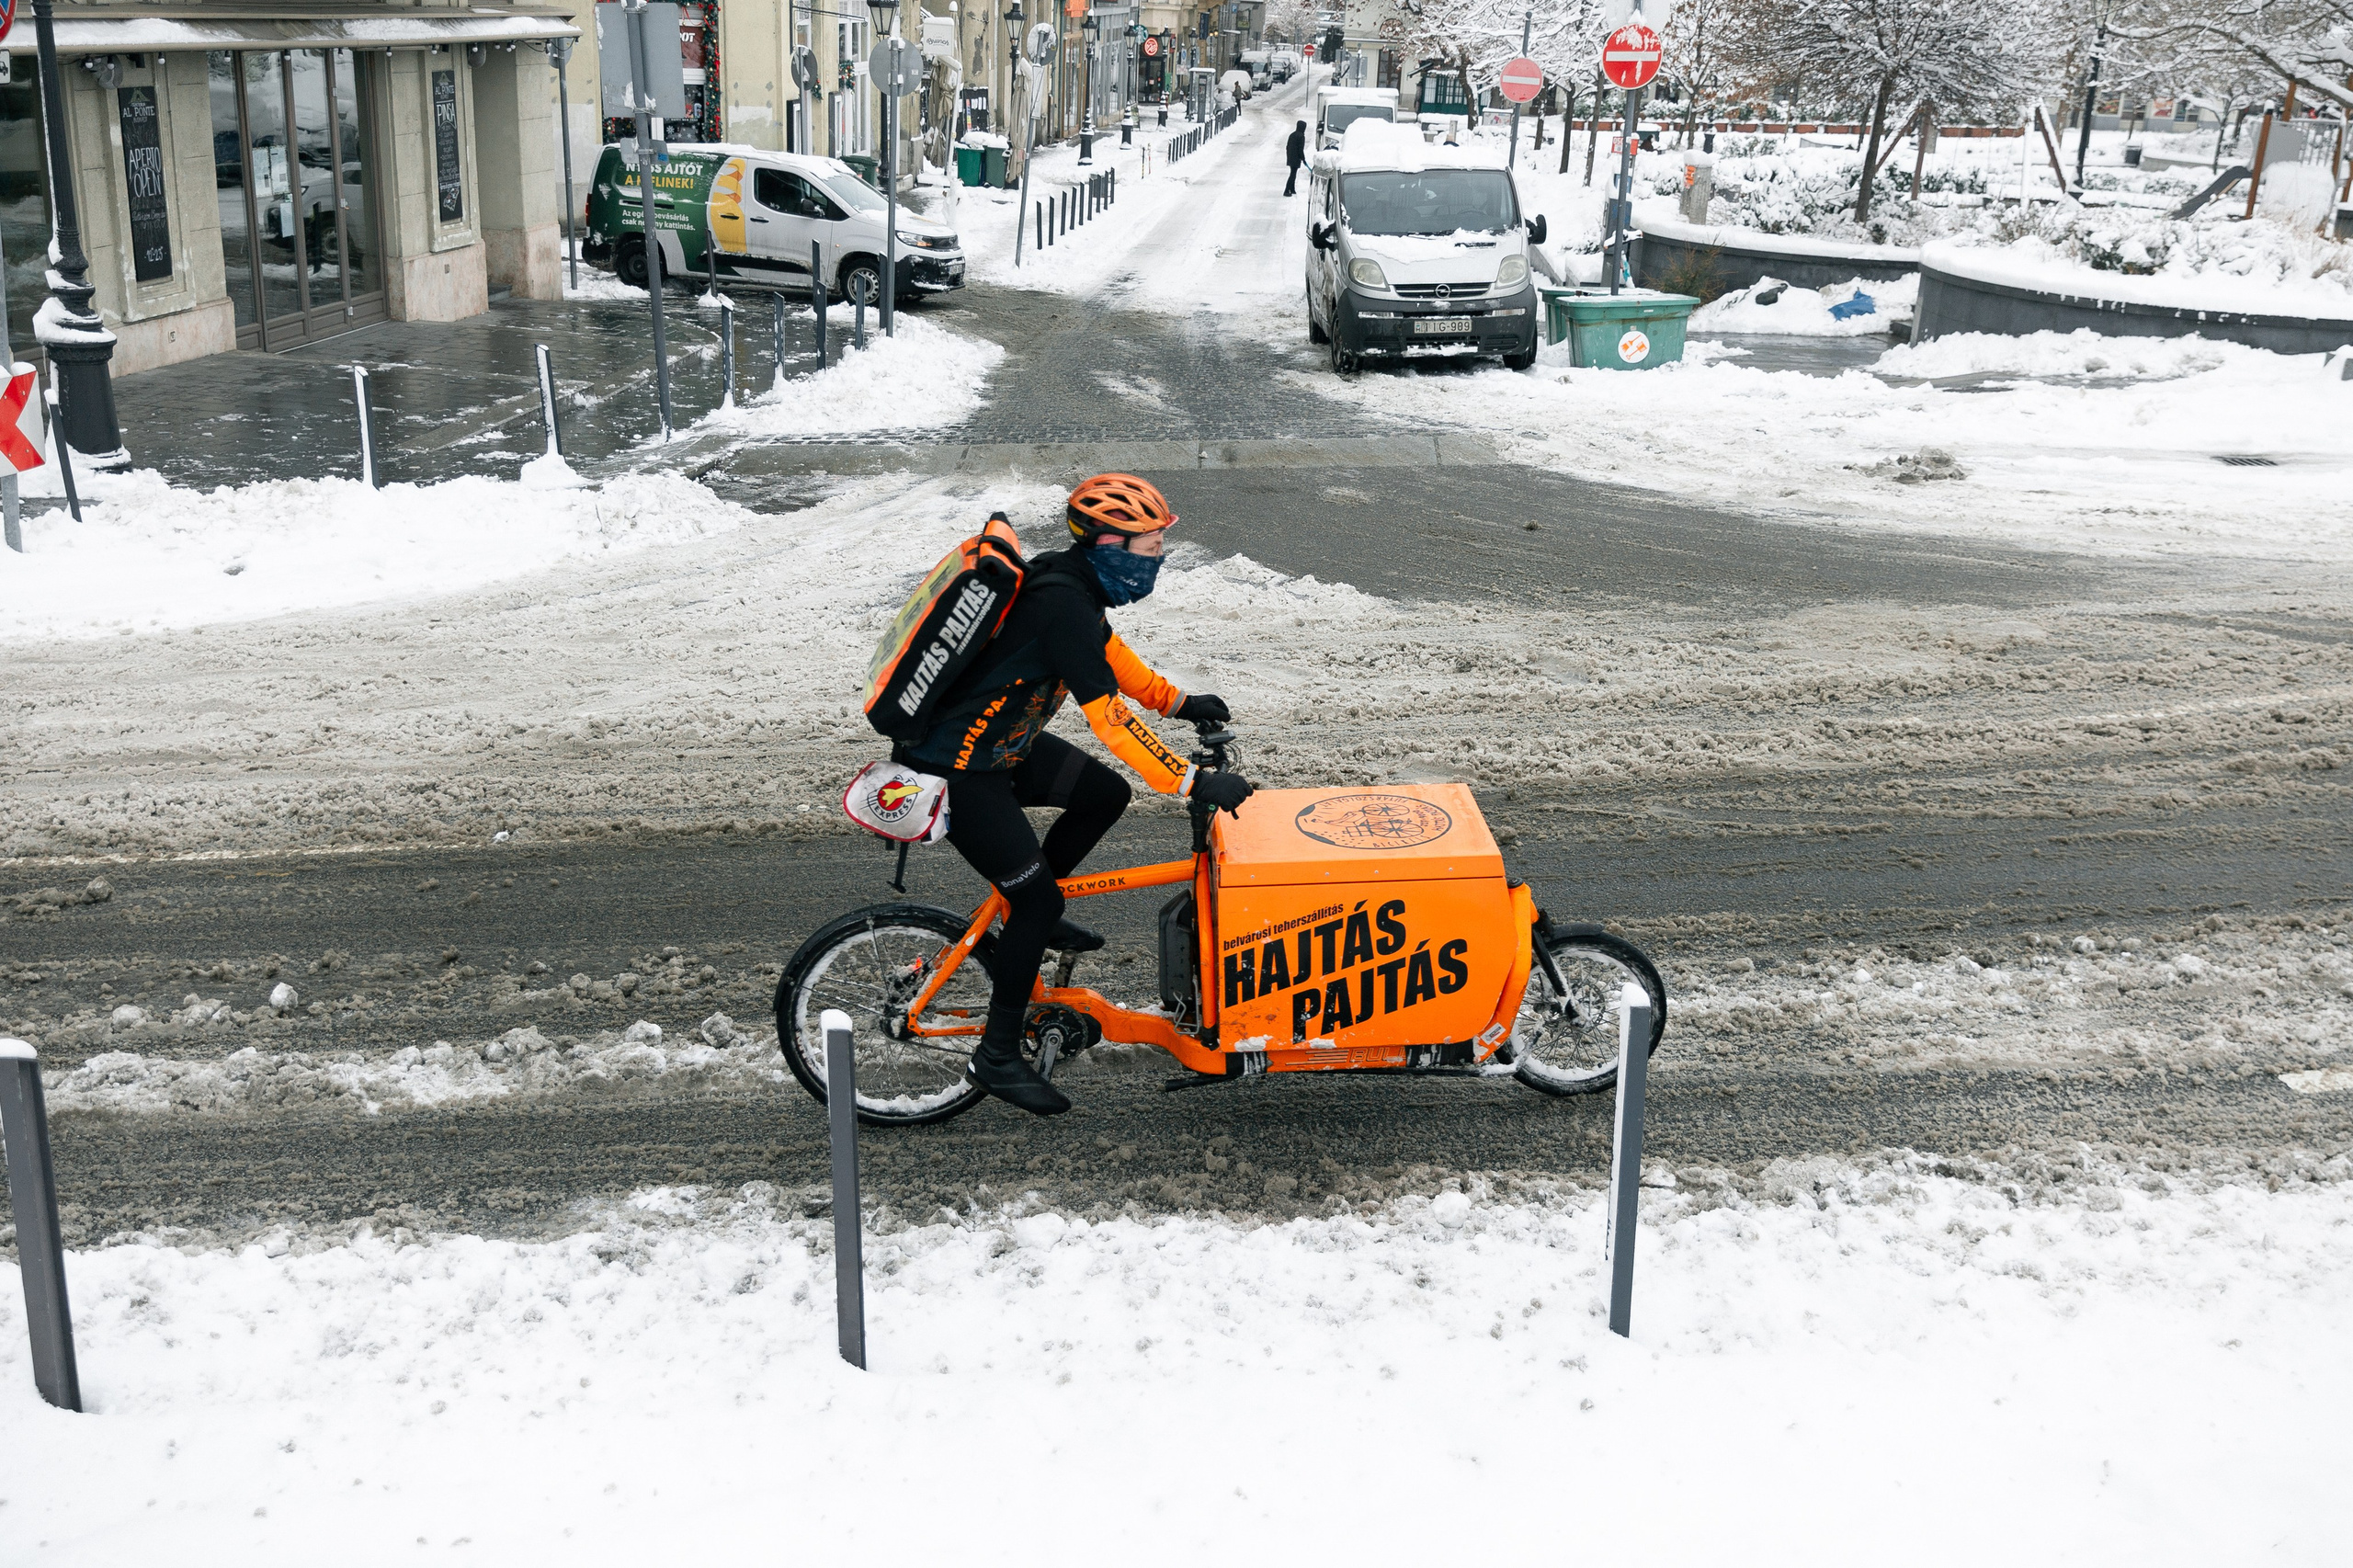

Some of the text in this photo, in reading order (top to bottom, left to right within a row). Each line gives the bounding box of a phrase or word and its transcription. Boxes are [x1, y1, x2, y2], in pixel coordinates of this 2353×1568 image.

[123, 106, 155, 118] AL PONTE
[437, 103, 458, 127] PINSA
[129, 147, 162, 179] APERTO
[664, 163, 704, 176] AJTÓT
[133, 167, 162, 198] OPEN
[625, 175, 634, 186] A
[622, 218, 637, 226] csak
[664, 221, 696, 232] kattintás.
[898, 641, 950, 717] HAJTÁS
[938, 578, 990, 649] PAJTÁS
[954, 718, 989, 770] HAJTÁS
[873, 797, 914, 819] EXPRESS
[1001, 862, 1040, 888] BonaVelo
[1223, 903, 1344, 951] belvárosi teherszállítás
[1223, 899, 1406, 1009] HAJTÁS
[1292, 937, 1469, 1045] PAJTÁS
